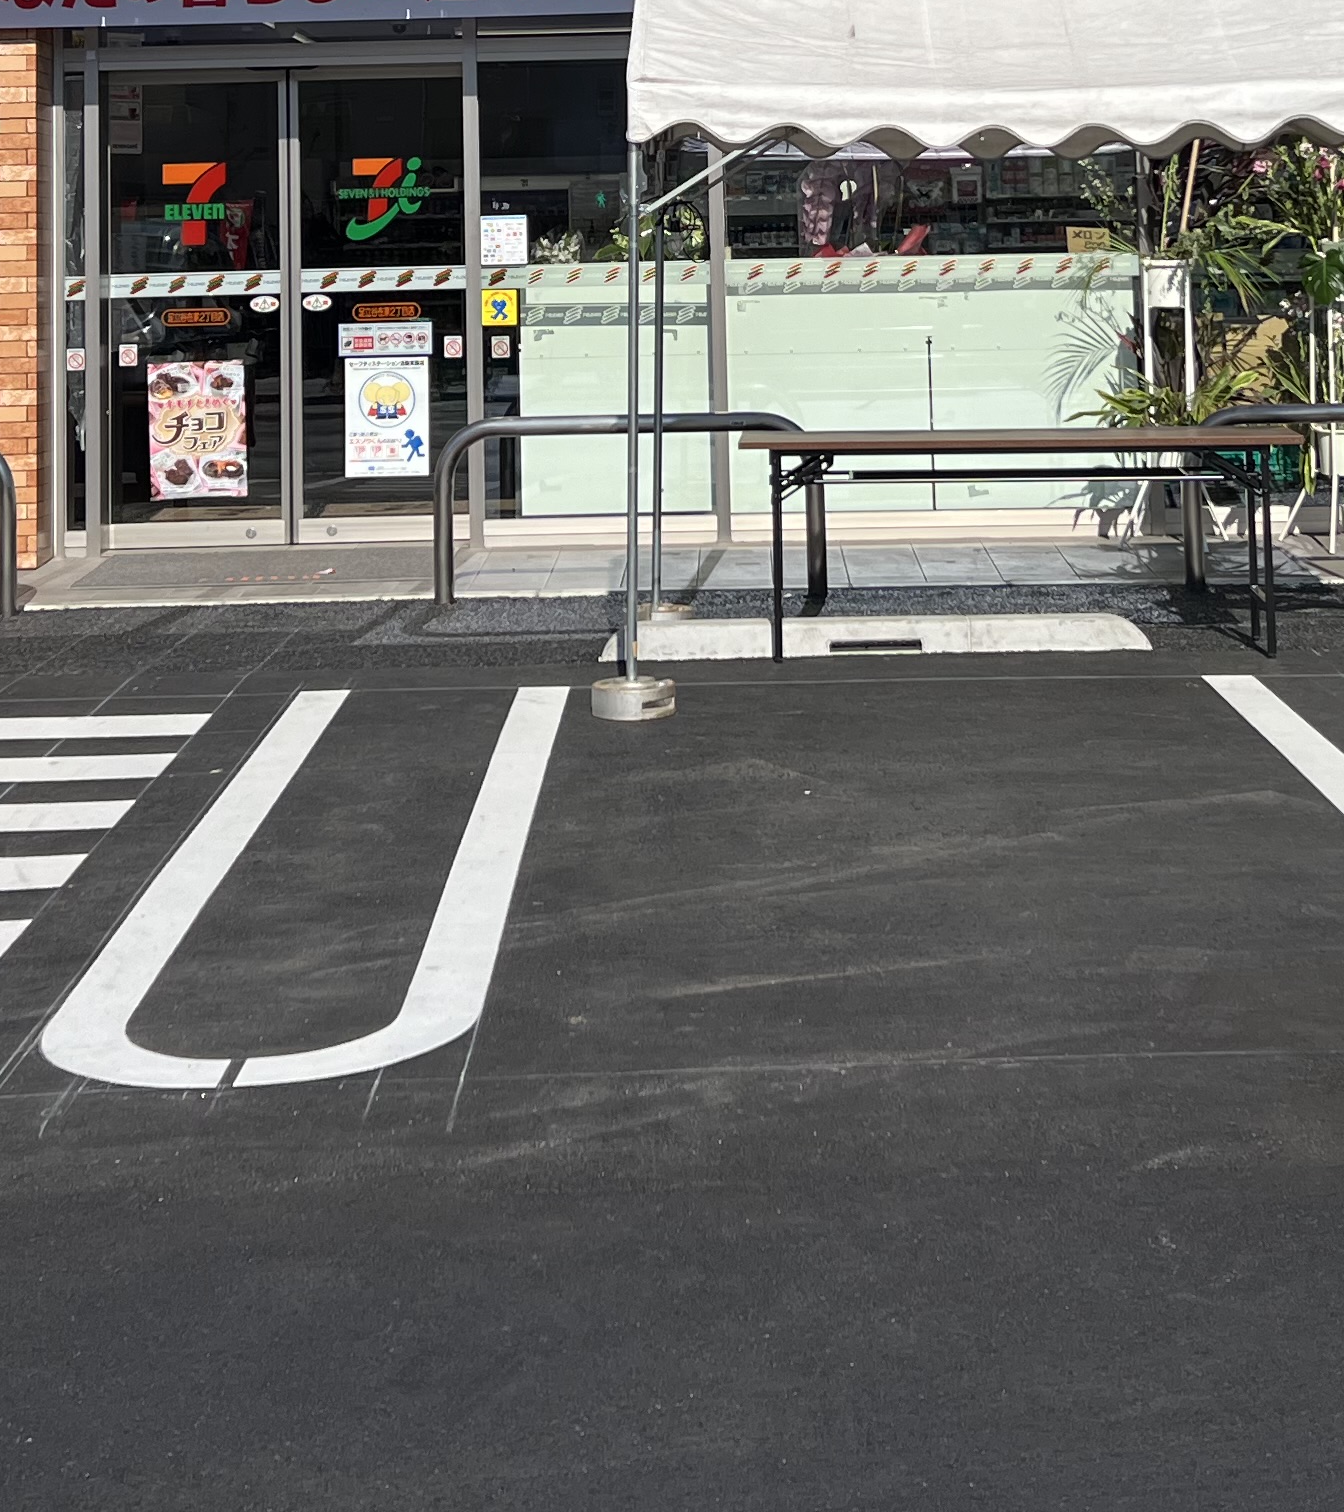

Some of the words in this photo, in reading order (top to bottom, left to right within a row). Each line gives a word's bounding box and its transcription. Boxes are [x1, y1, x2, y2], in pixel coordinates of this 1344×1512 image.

[162, 162, 226, 246] 7
[152, 411, 224, 445] チョコ
[183, 435, 223, 449] フェア
